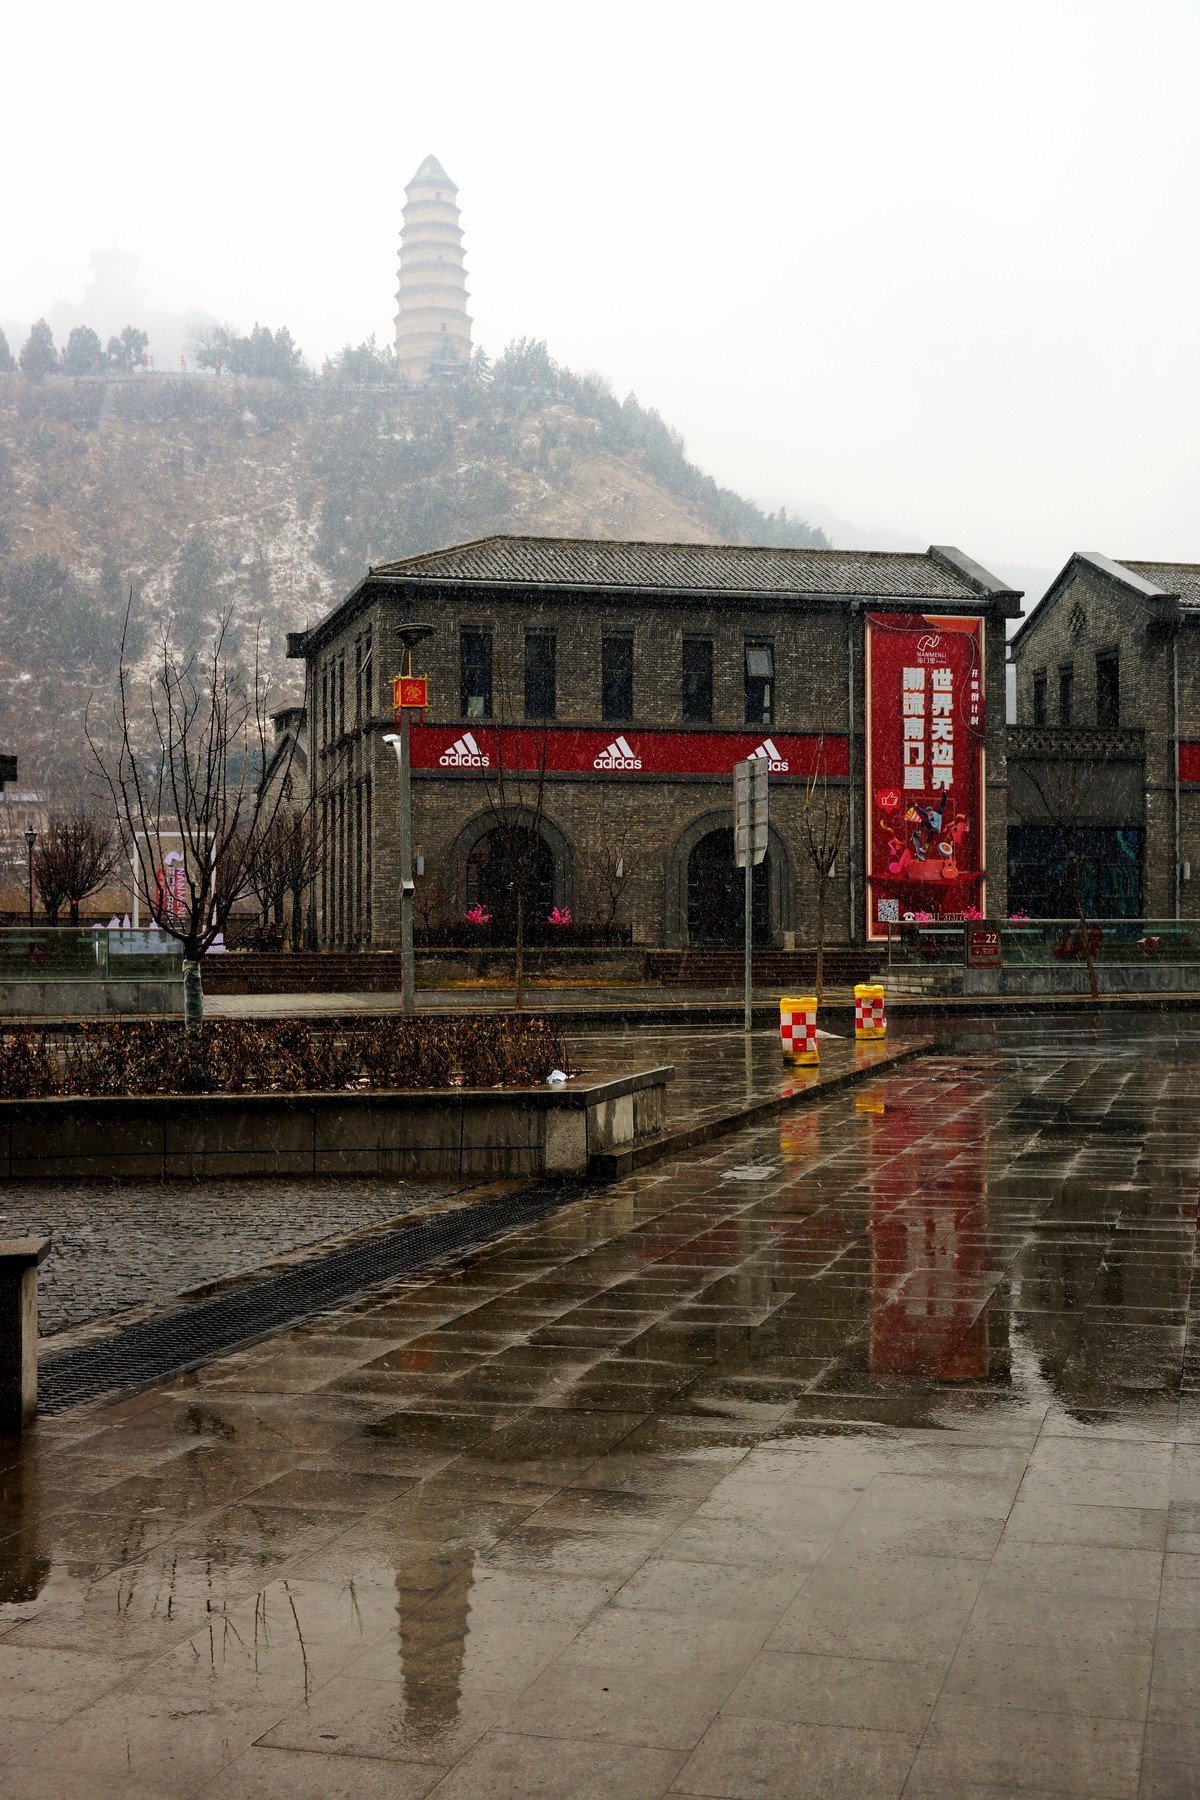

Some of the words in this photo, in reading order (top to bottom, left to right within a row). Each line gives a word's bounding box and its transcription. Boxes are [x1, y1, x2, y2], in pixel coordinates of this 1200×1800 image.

[903, 667, 925, 789] 潮流南门里
[932, 668, 954, 790] 世界无边界
[439, 753, 489, 767] adidas
[593, 756, 642, 770] adidas
[985, 933, 997, 944] 22
